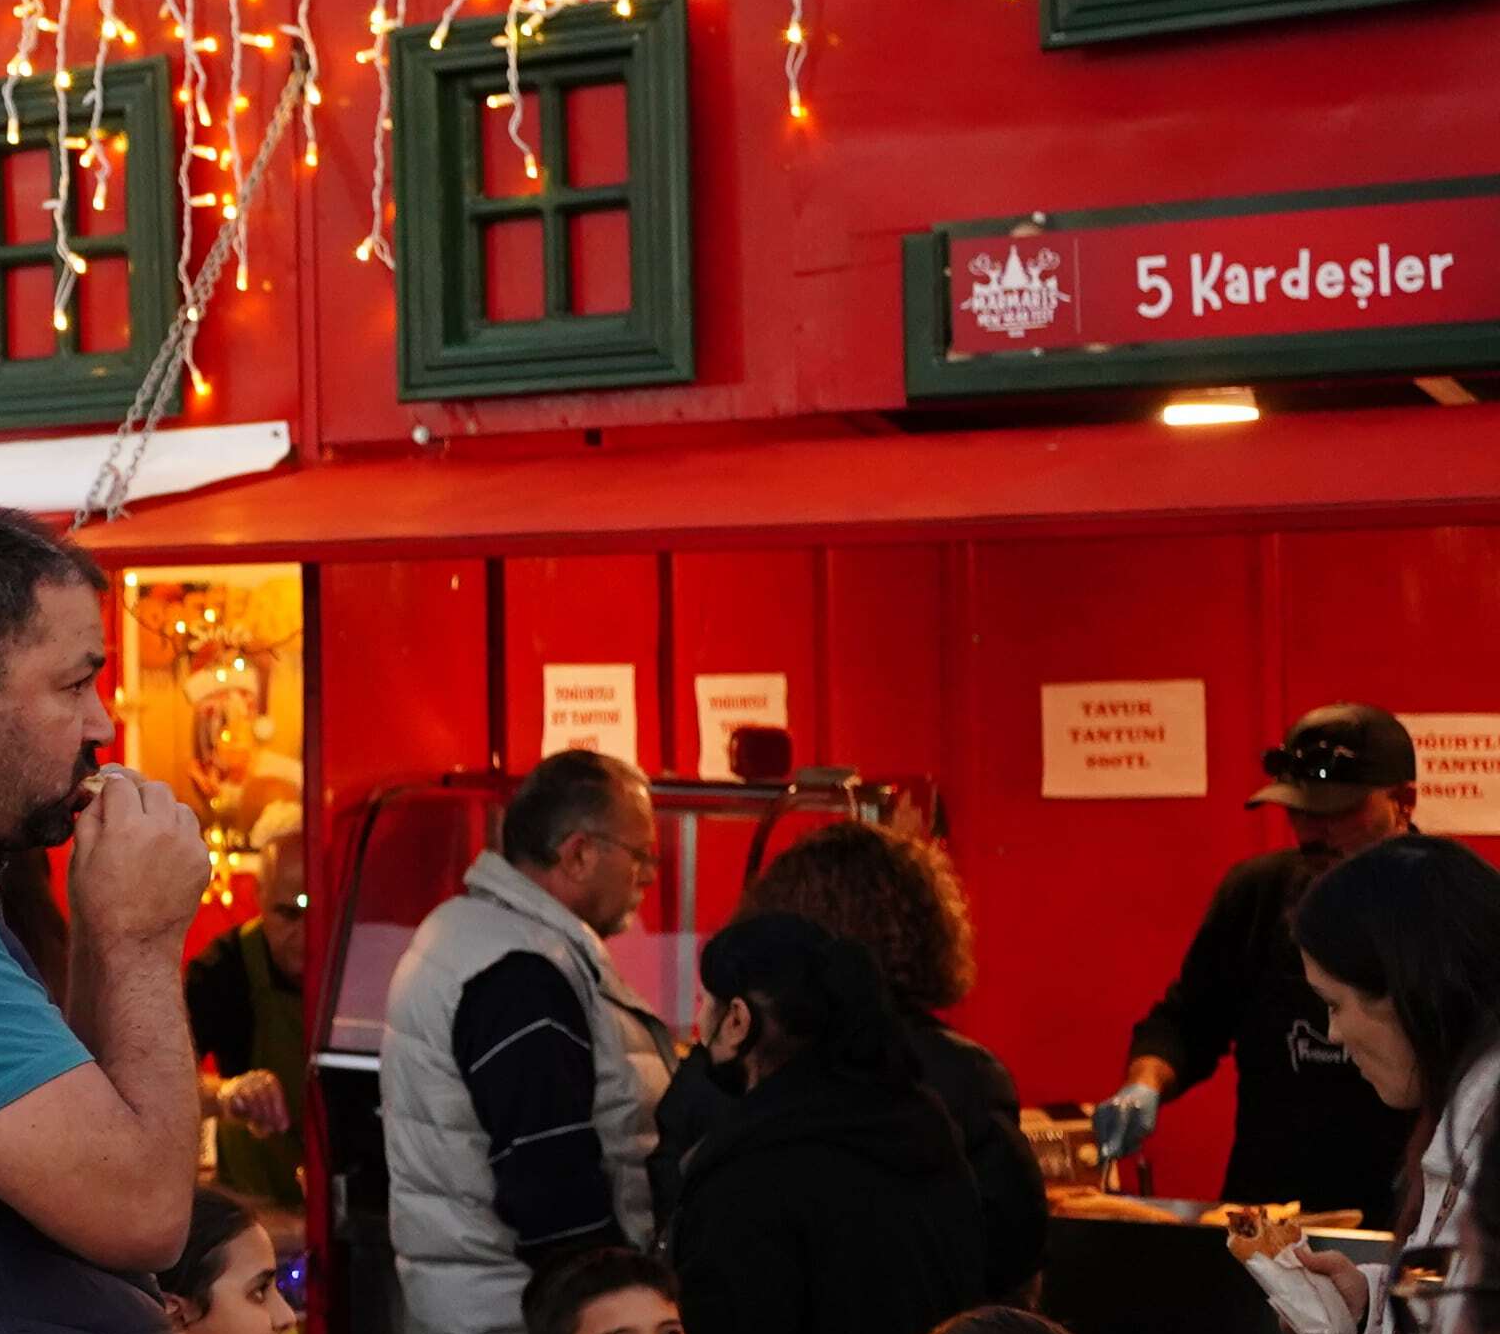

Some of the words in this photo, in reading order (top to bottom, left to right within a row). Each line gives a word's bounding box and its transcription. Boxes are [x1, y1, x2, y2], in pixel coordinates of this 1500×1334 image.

[1136, 253, 1174, 319] 5
[1189, 242, 1455, 317] Kardeşler
[1415, 731, 1500, 750] OĞURTL
[1422, 759, 1500, 774] TANTU
